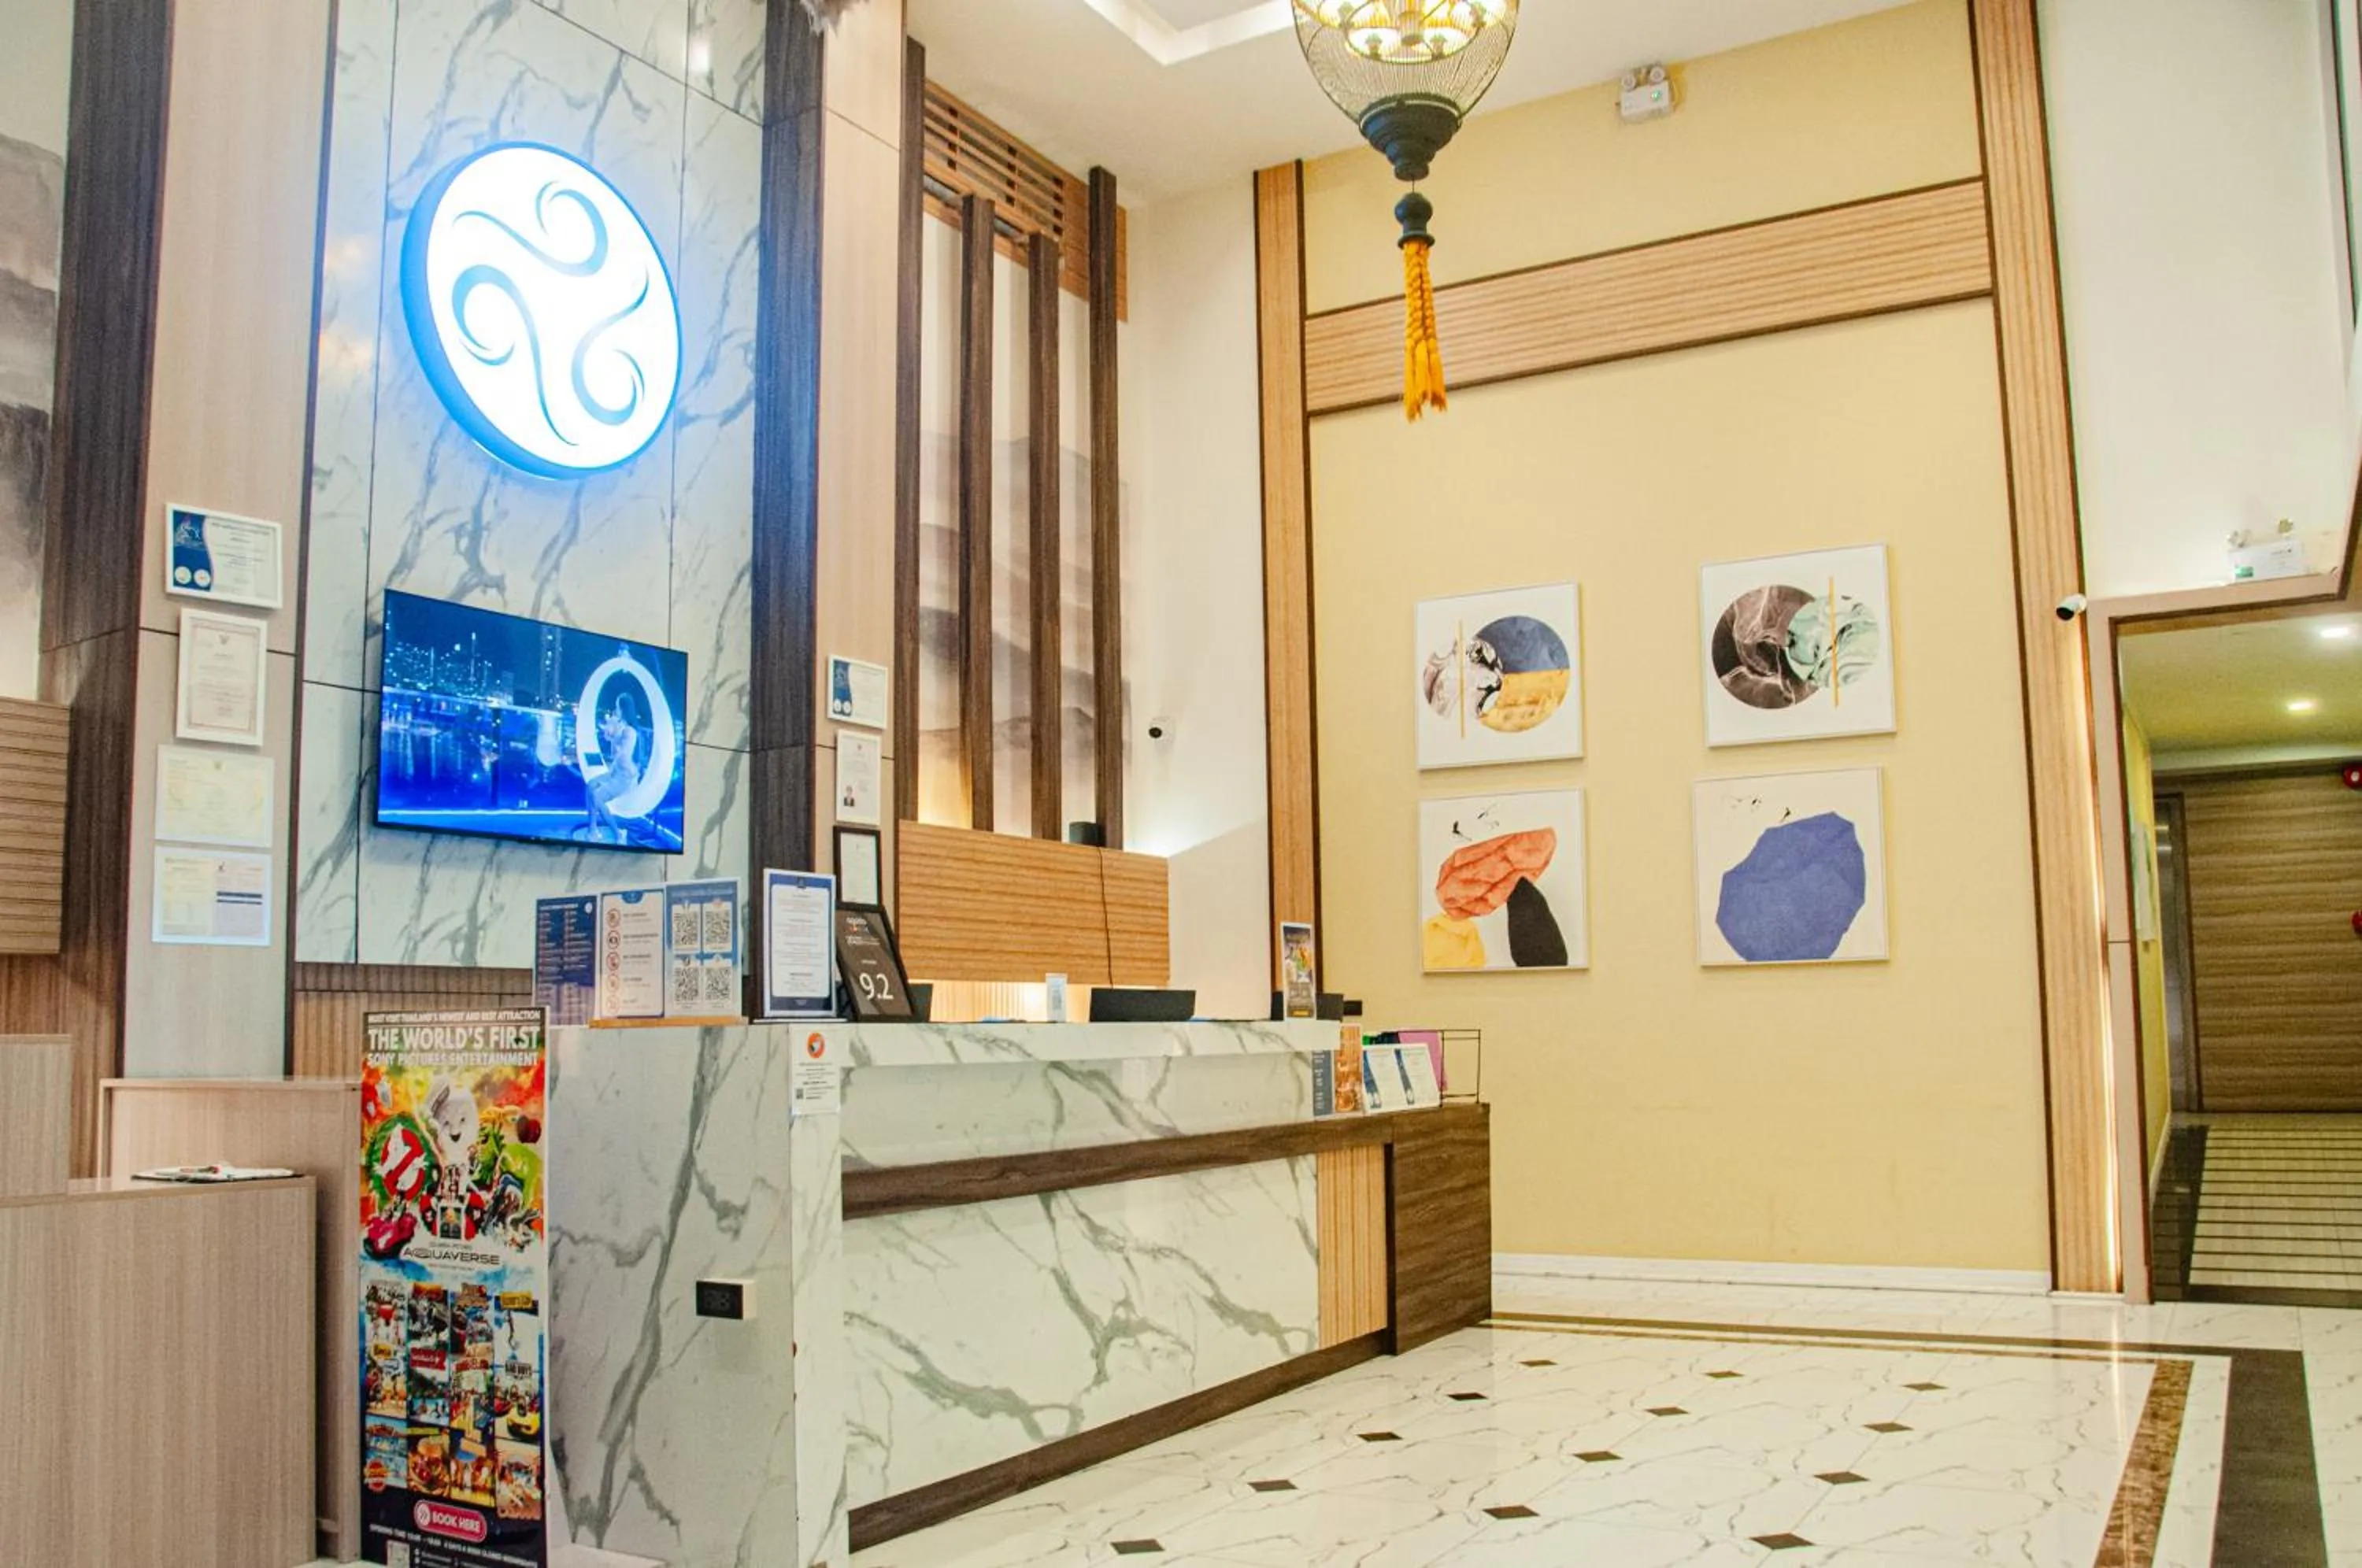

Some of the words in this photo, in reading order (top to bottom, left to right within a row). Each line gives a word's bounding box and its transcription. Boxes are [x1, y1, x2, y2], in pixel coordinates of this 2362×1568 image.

[859, 972, 894, 1000] 9.2
[498, 1009, 540, 1021] ATTRACTION
[368, 1027, 399, 1051] THE
[402, 1026, 484, 1050] WORLD'S
[490, 1025, 541, 1049] FIRST
